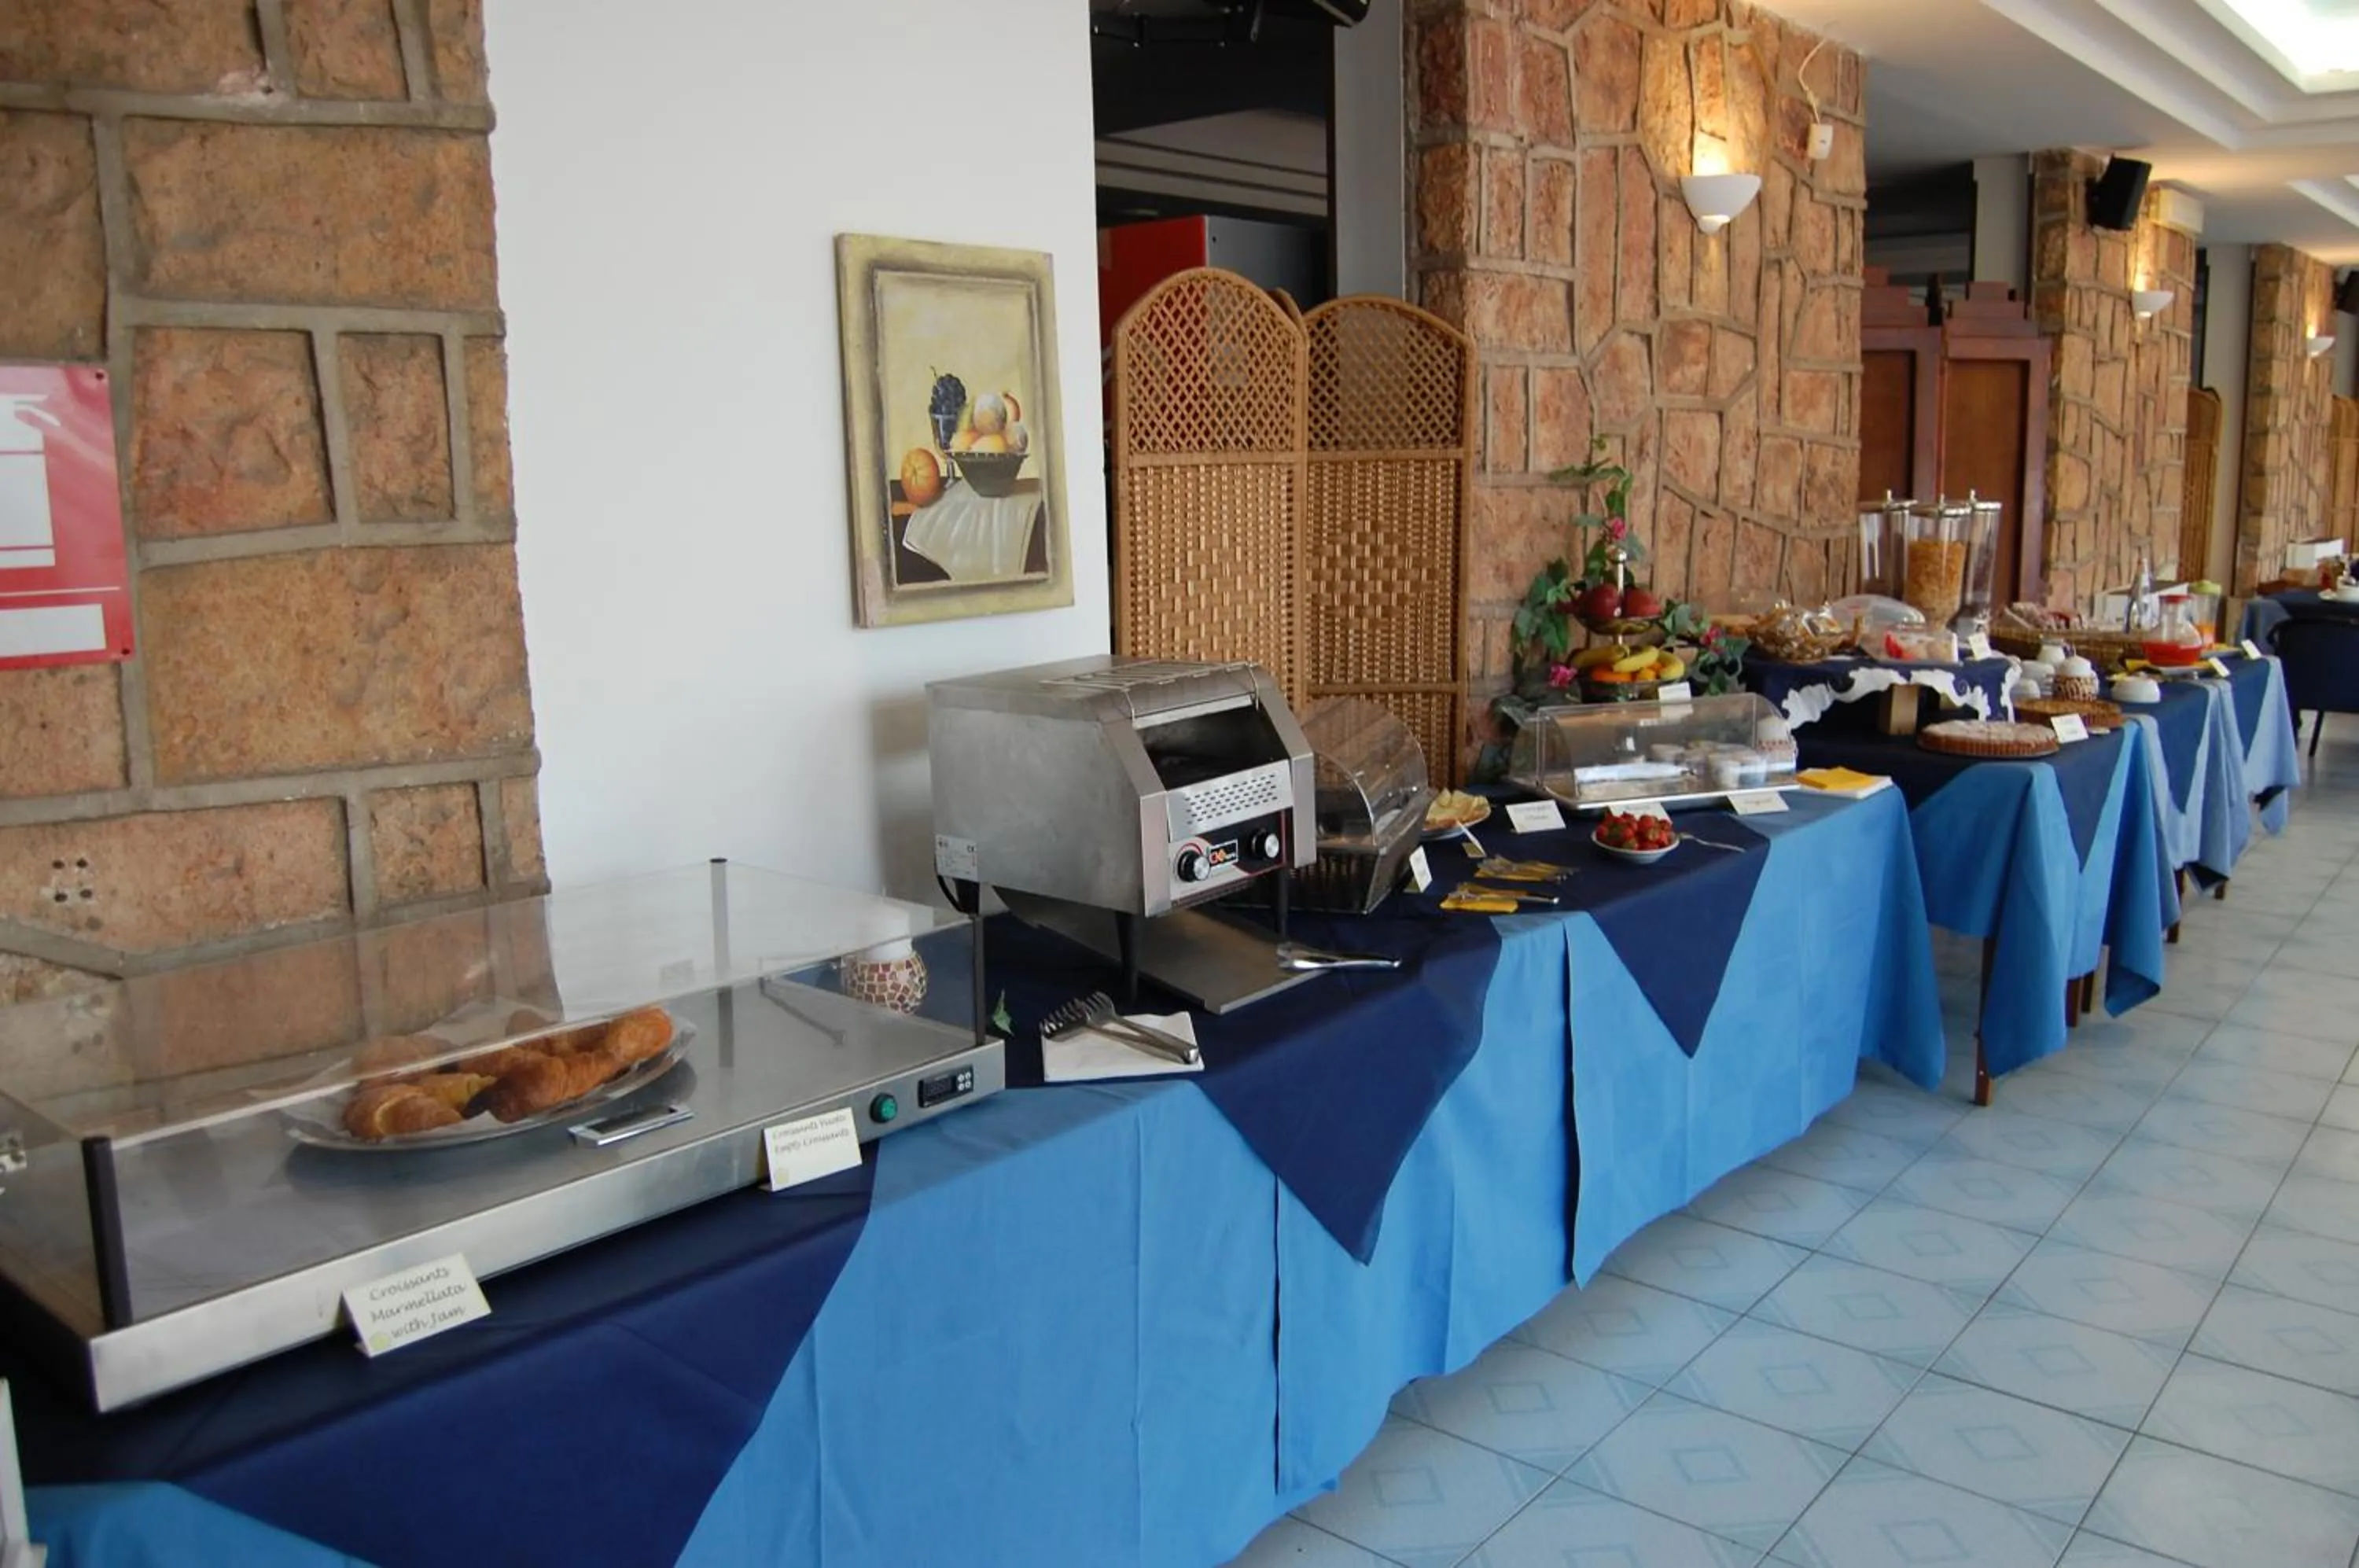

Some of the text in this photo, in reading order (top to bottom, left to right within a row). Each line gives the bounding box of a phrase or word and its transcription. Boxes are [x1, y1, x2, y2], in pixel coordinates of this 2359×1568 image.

[369, 1267, 450, 1301] Croissants
[370, 1283, 467, 1323] Marmellata
[391, 1318, 429, 1338] with
